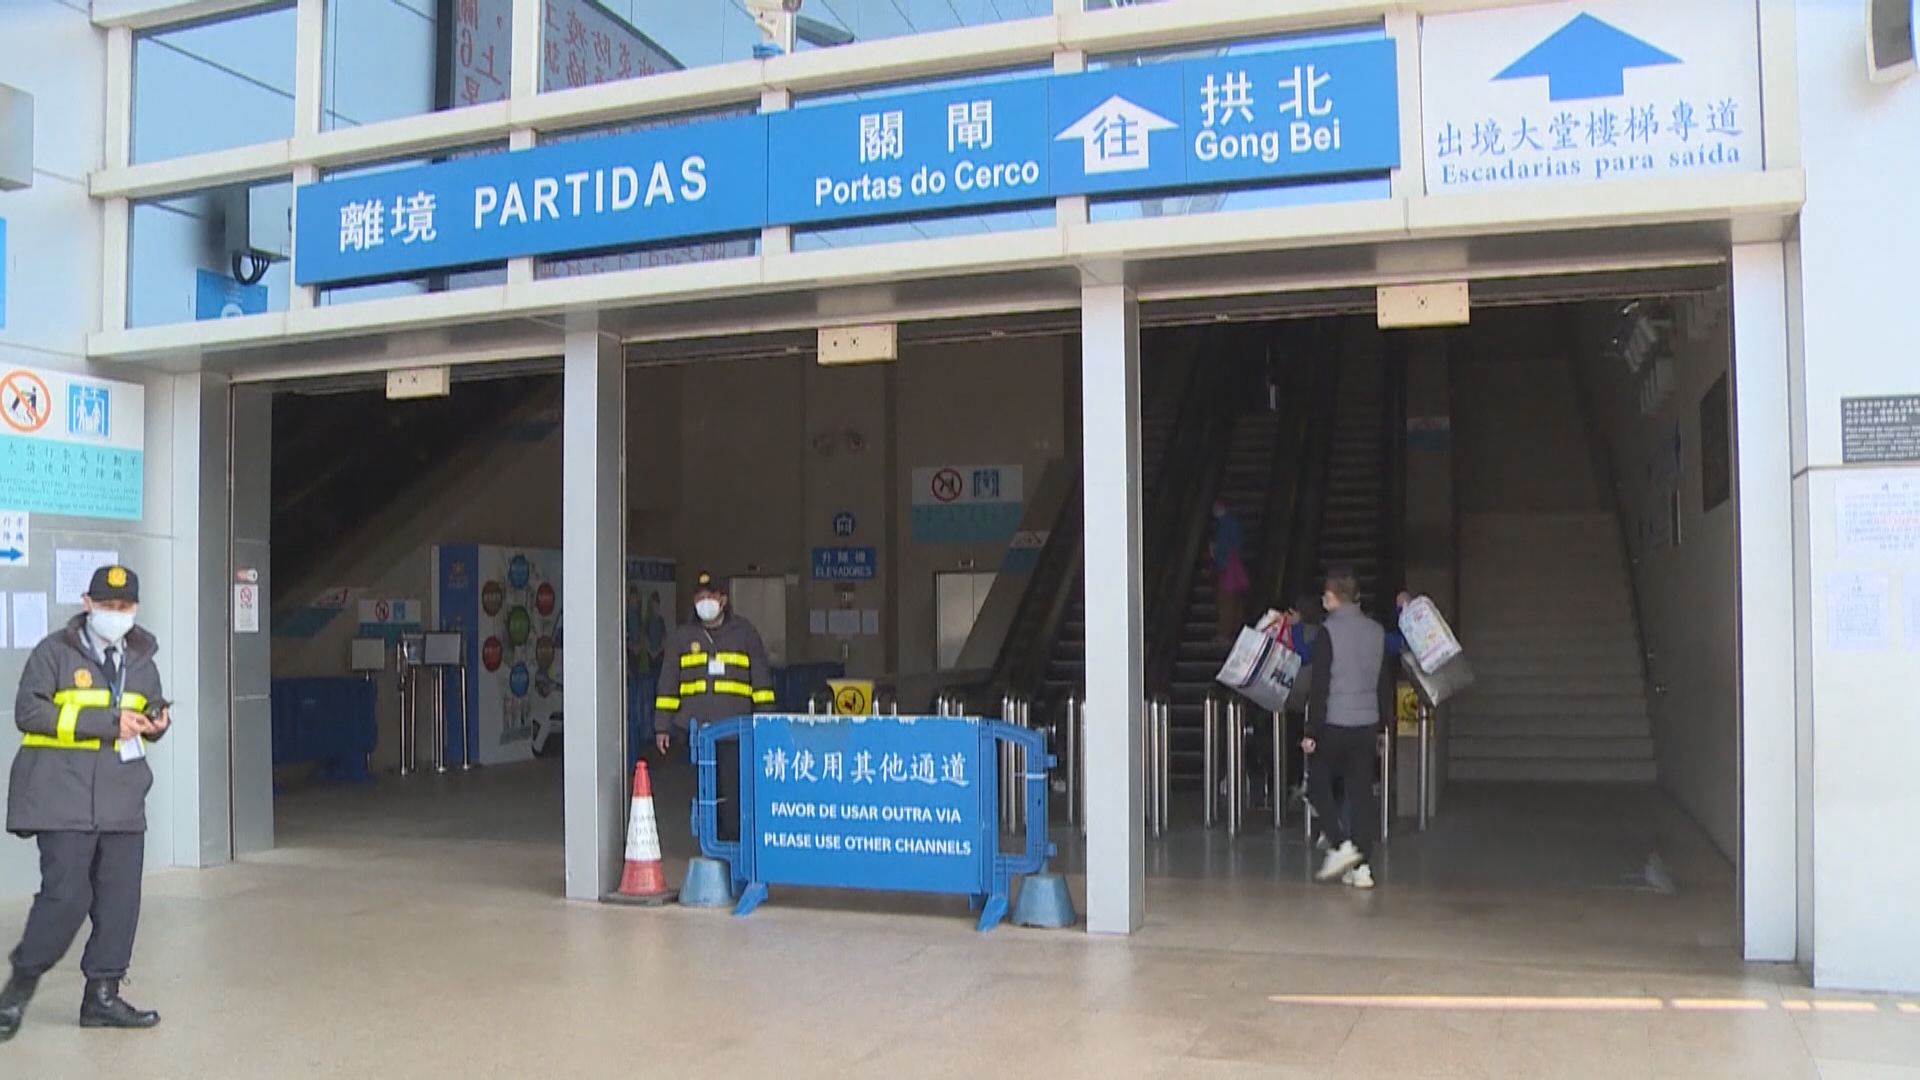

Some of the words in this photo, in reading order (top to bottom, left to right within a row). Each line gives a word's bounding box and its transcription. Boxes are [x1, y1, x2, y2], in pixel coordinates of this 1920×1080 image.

[1200, 65, 1333, 127] 拱北
[859, 100, 993, 163] 關閘
[1092, 115, 1140, 160] 往
[1194, 130, 1279, 162] Gong
[1289, 120, 1341, 153] Bei
[1437, 97, 1743, 158] 出境大堂樓梯專道
[815, 173, 902, 206] Portas
[911, 167, 946, 196] do
[954, 161, 1040, 191] Cerco
[1441, 156, 1581, 185] Escadarias
[1596, 151, 1654, 179] para
[1669, 142, 1740, 168] saída
[475, 155, 707, 230] PARTIDAS
[339, 190, 437, 253] 離境
[815, 566, 873, 577] ELEVADORES
[763, 747, 970, 787] 請使用其他通道
[772, 802, 816, 817] FAVOR
[819, 804, 836, 818] DE
[841, 805, 878, 820] USAR
[882, 807, 932, 822] OUTRA
[936, 809, 961, 823] VIA
[764, 832, 811, 848] PLEASE
[815, 834, 841, 849] USE
[845, 836, 891, 852] OTHER
[895, 838, 971, 855] CHANNELS
